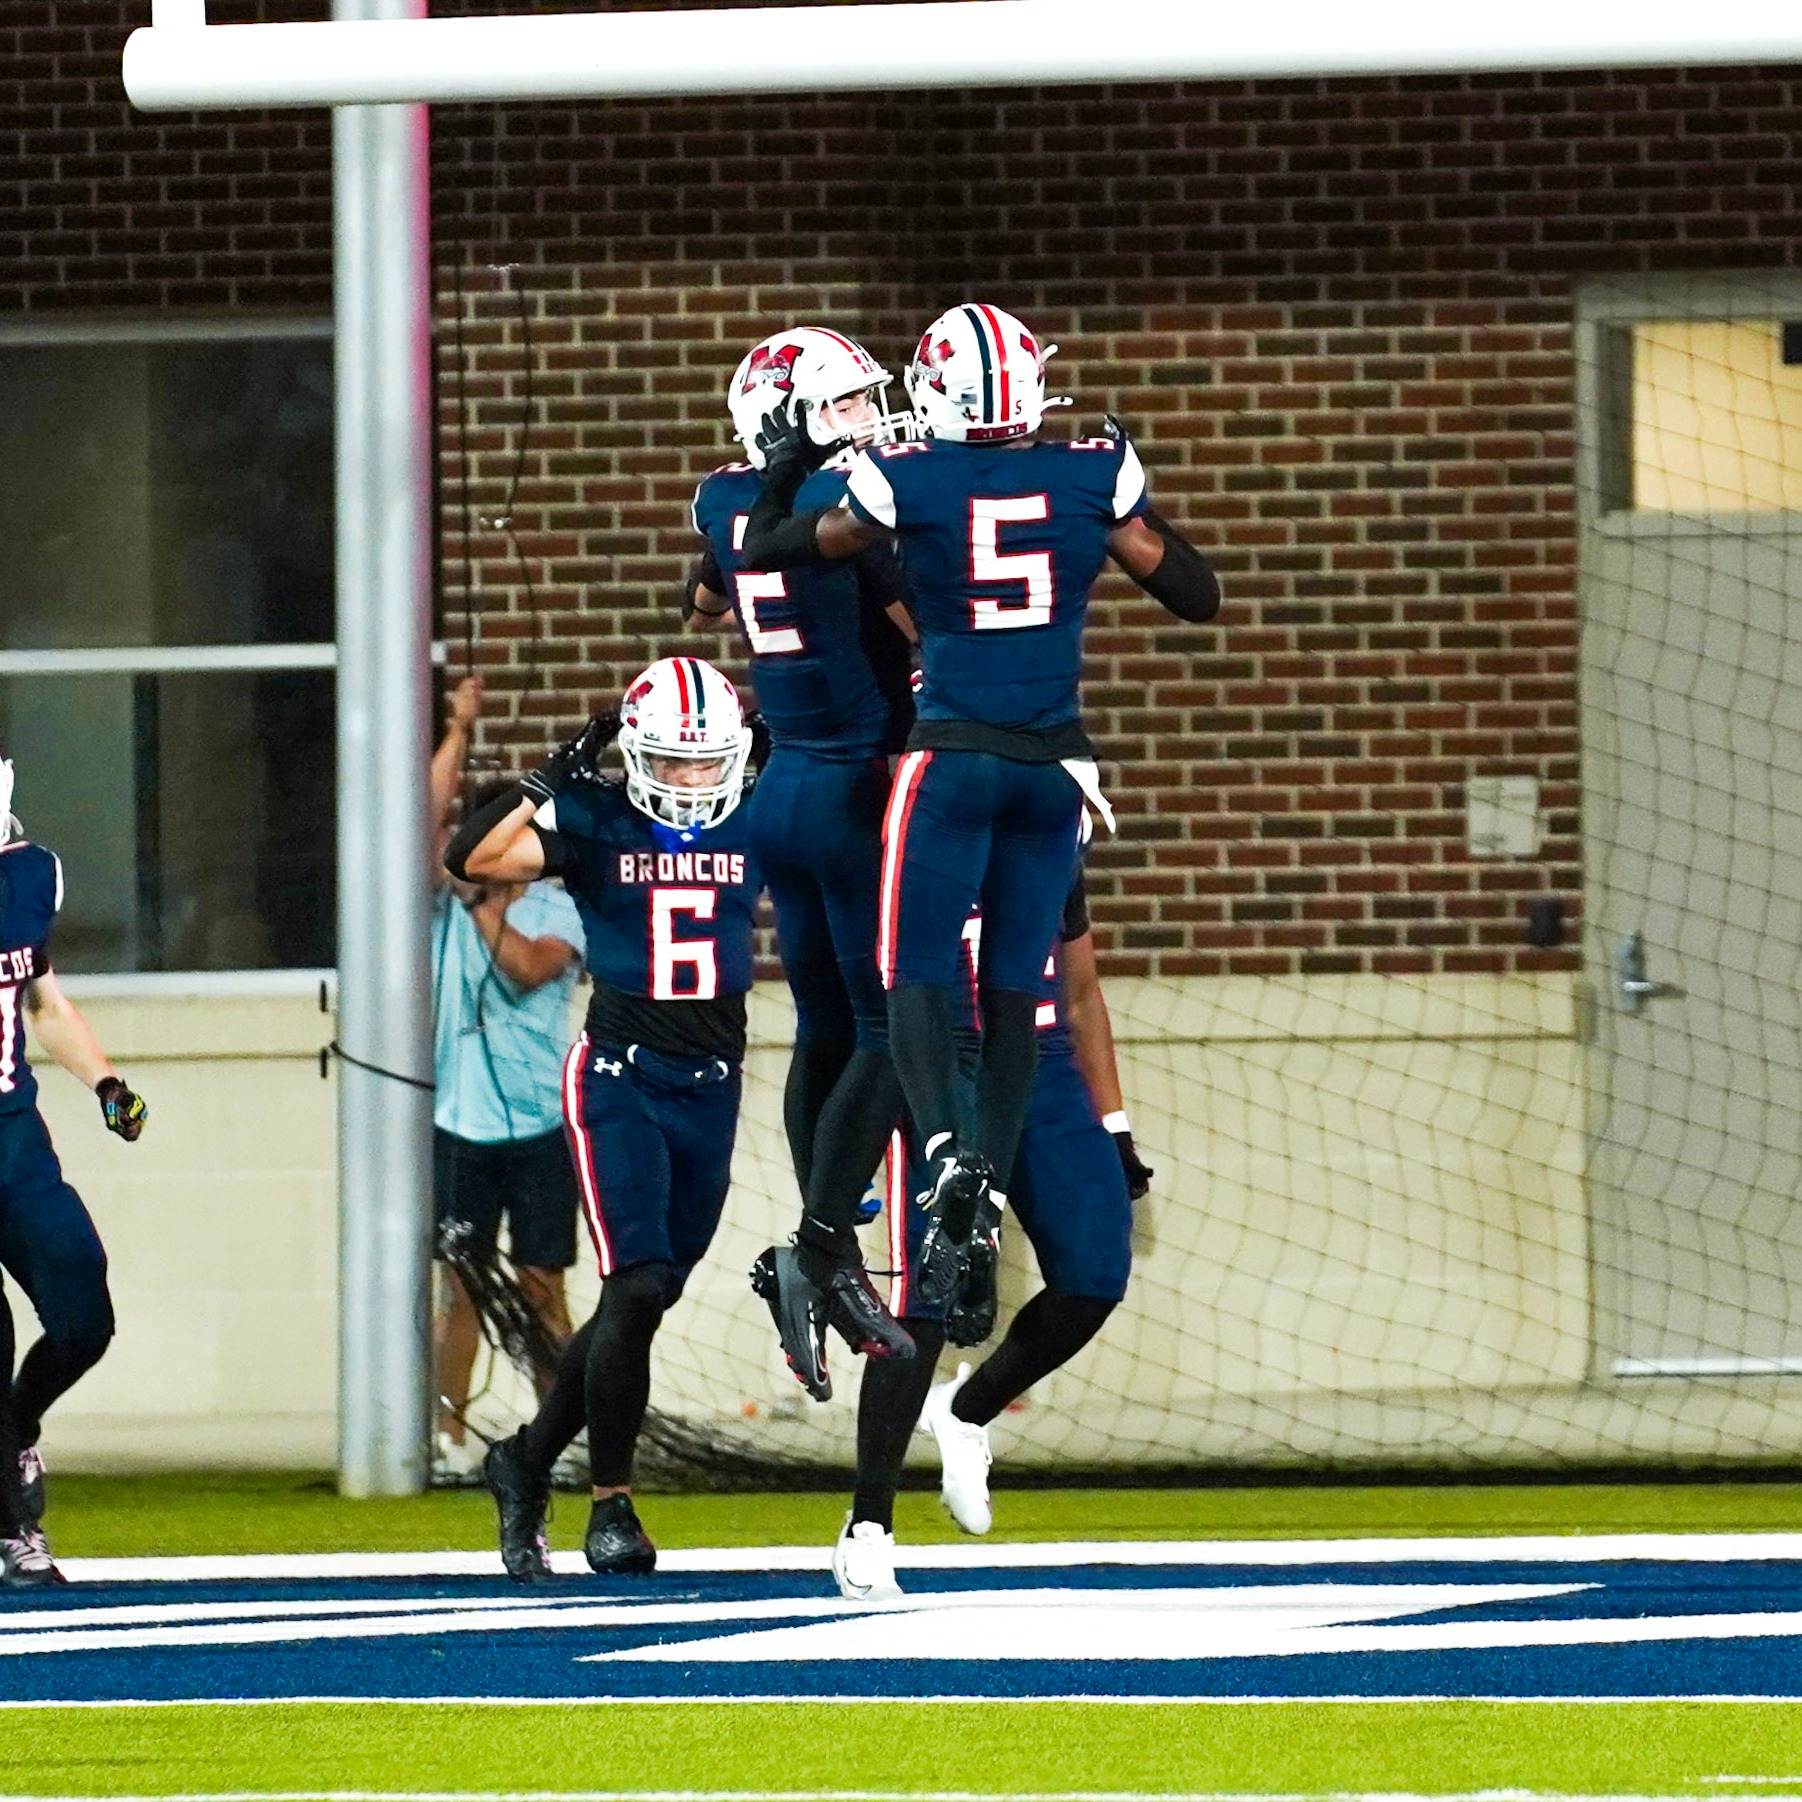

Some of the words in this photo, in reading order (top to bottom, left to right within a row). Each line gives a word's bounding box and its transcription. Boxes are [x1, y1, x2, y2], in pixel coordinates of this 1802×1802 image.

[970, 493, 1053, 630] 5
[620, 852, 744, 884] BRONCOS
[649, 886, 718, 1000] 6
